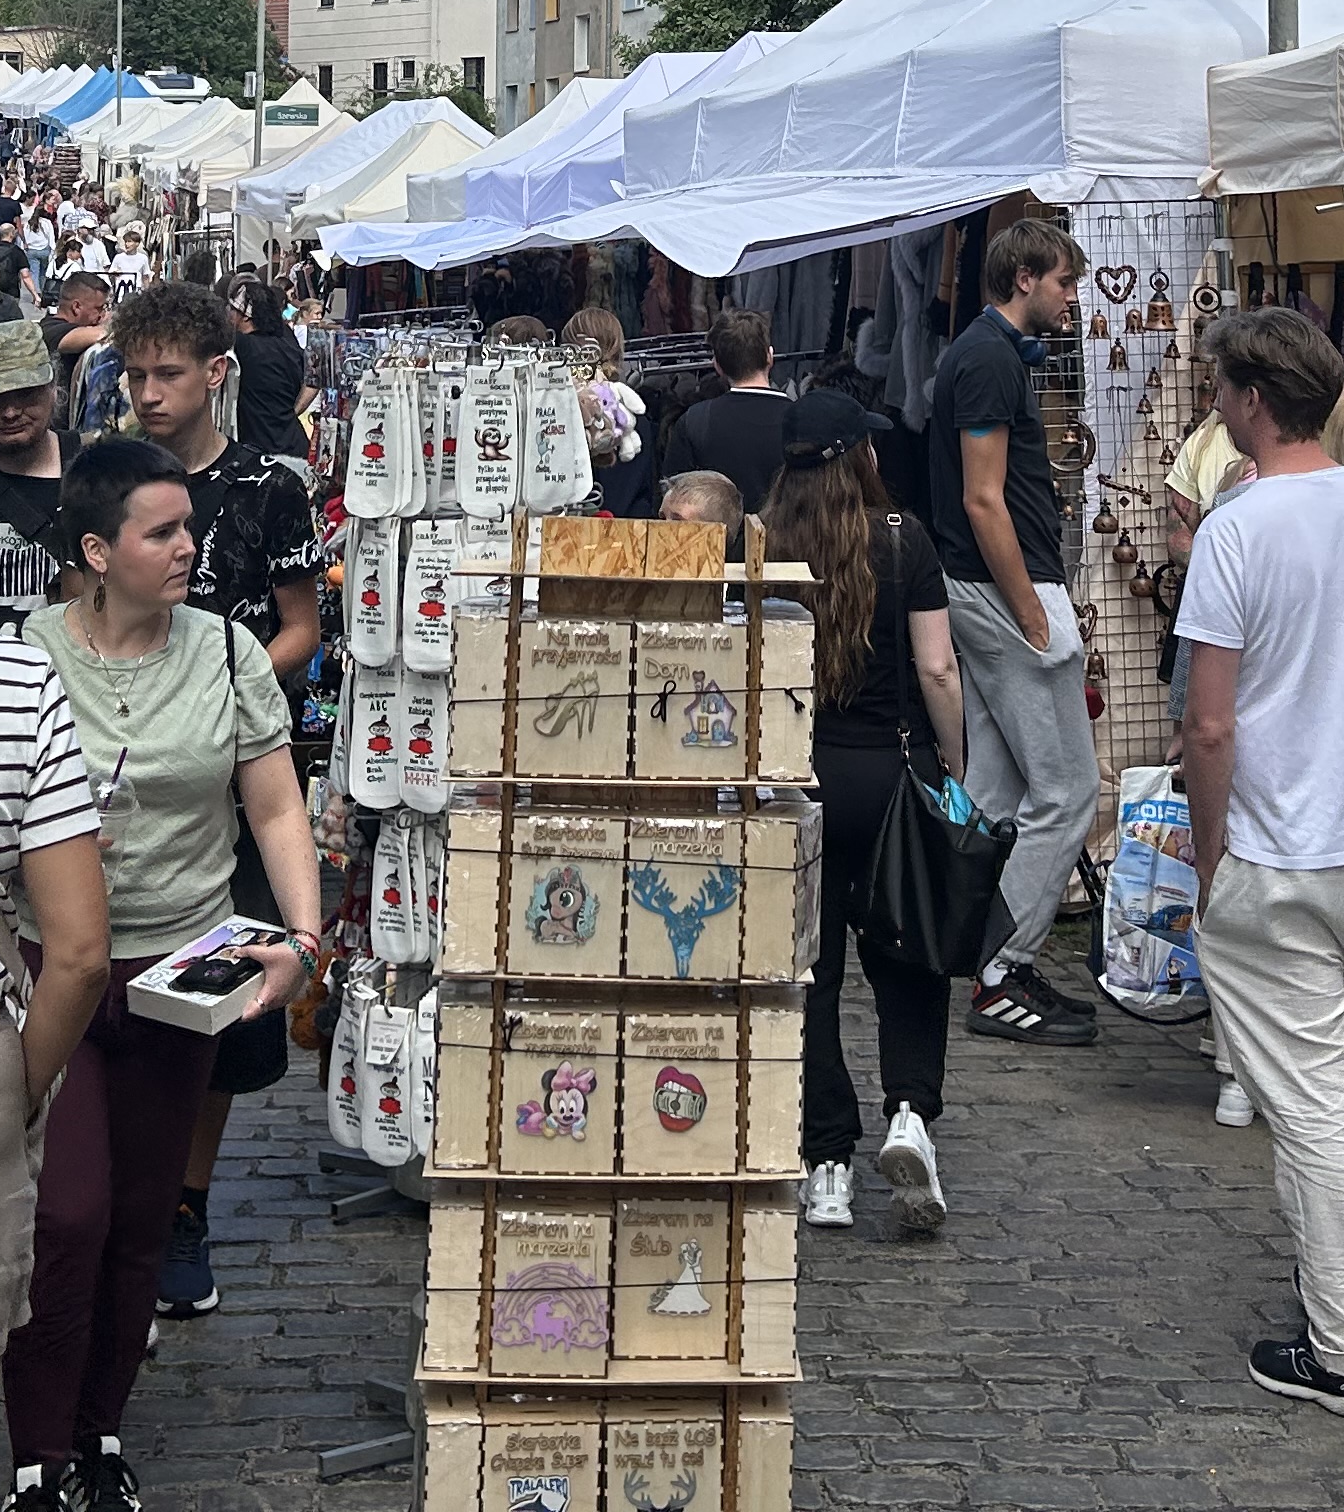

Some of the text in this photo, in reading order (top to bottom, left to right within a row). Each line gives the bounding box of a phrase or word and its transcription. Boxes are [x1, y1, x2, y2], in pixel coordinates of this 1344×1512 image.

[535, 407, 556, 418] PRACA
[641, 632, 733, 650] Zbieram na
[644, 656, 690, 680] Dom
[650, 840, 724, 858] marzenia
[513, 1023, 601, 1040] Zbieram na
[631, 1023, 724, 1041] Zbieram na
[525, 1042, 597, 1059] marzenia
[646, 1043, 720, 1059] marzenia
[622, 1209, 714, 1228] Zbieram na
[501, 1219, 594, 1239] Zbieram na
[516, 1240, 590, 1257] marzenia
[630, 1231, 673, 1257] Ślub
[505, 1431, 582, 1453] Skarbonka
[614, 1429, 639, 1447] Nie
[509, 1476, 569, 1500] TRALALERO
